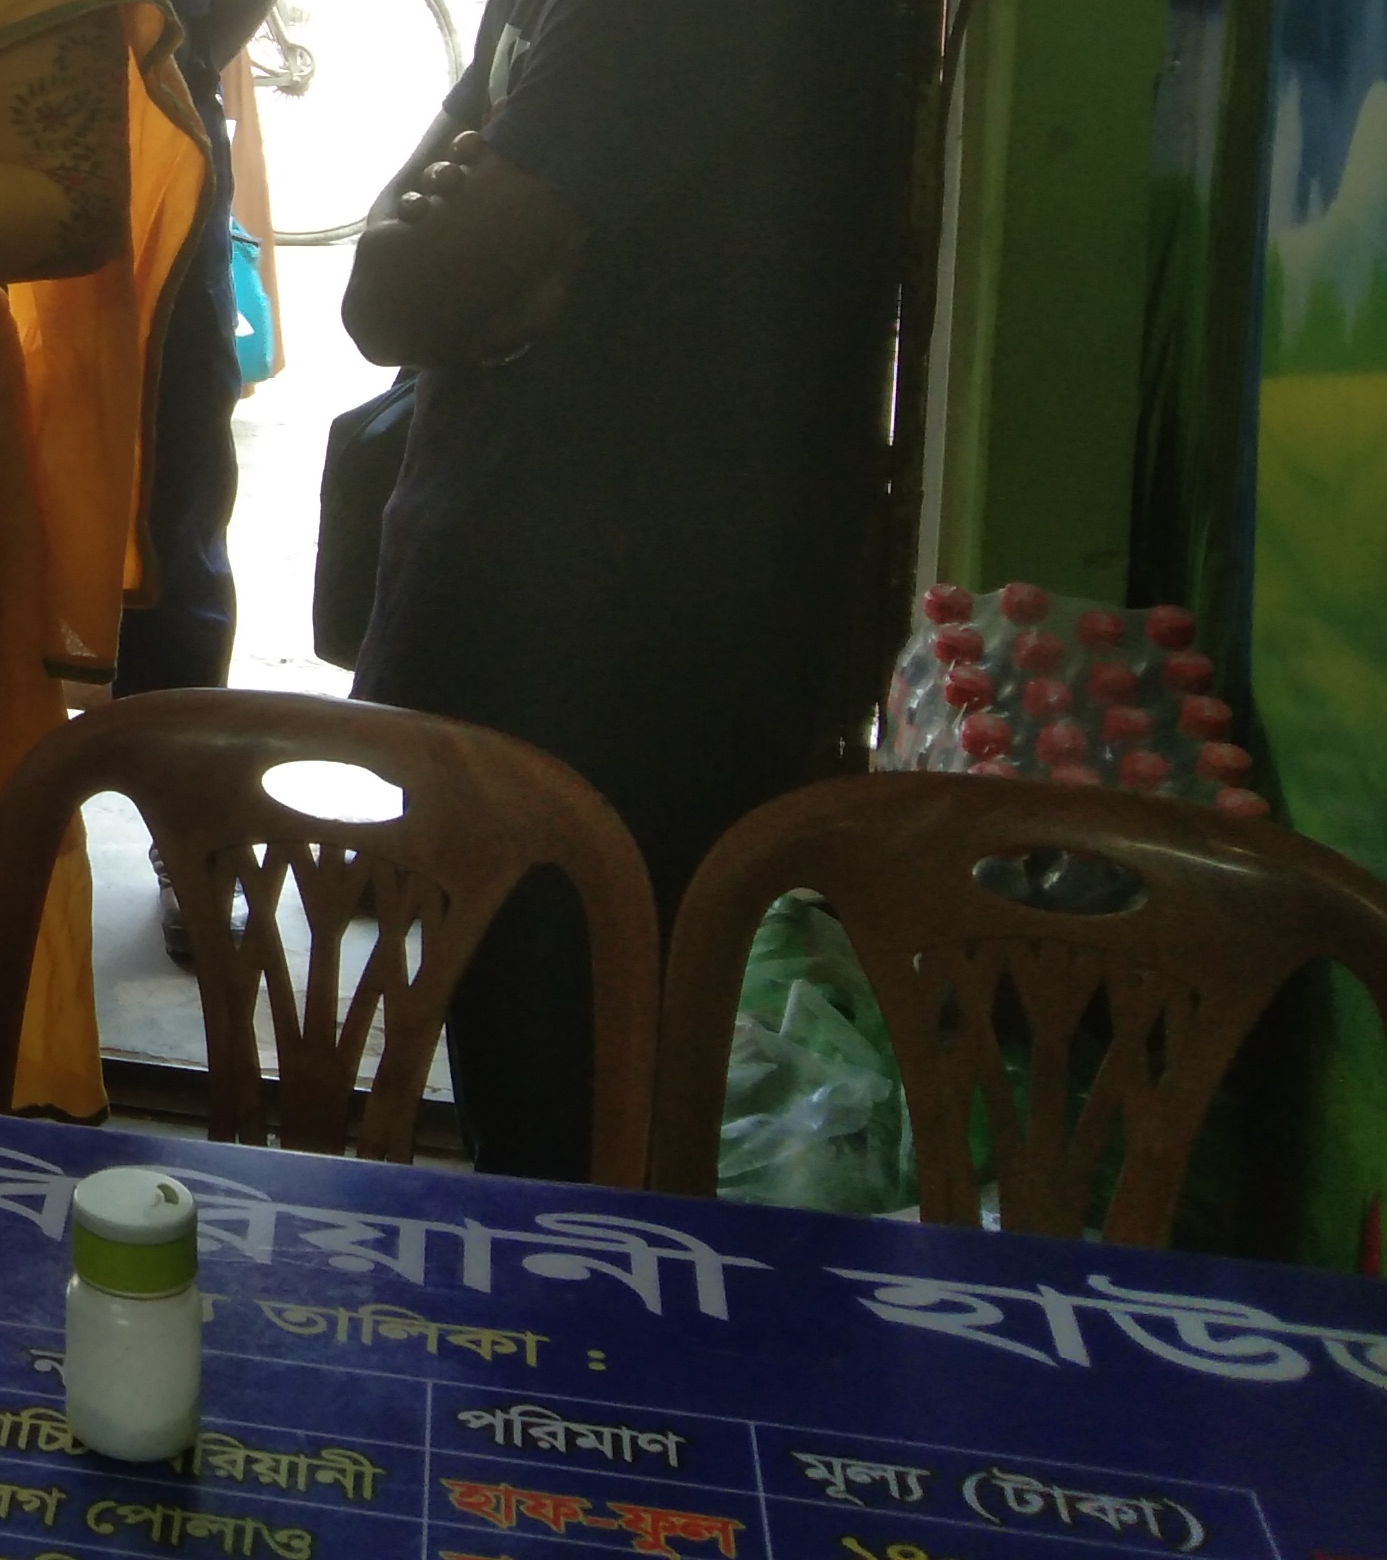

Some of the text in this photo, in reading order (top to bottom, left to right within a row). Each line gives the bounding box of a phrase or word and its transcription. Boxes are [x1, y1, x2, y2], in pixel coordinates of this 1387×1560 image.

[252, 1302, 550, 1368] তালিকা
[456, 1403, 686, 1468] পরিমাণ
[789, 1450, 930, 1507] মূল্য
[961, 1466, 1206, 1554] (টাকা)
[85, 1500, 312, 1560] পোলাও
[440, 1478, 745, 1560] হাফ-ফুল
